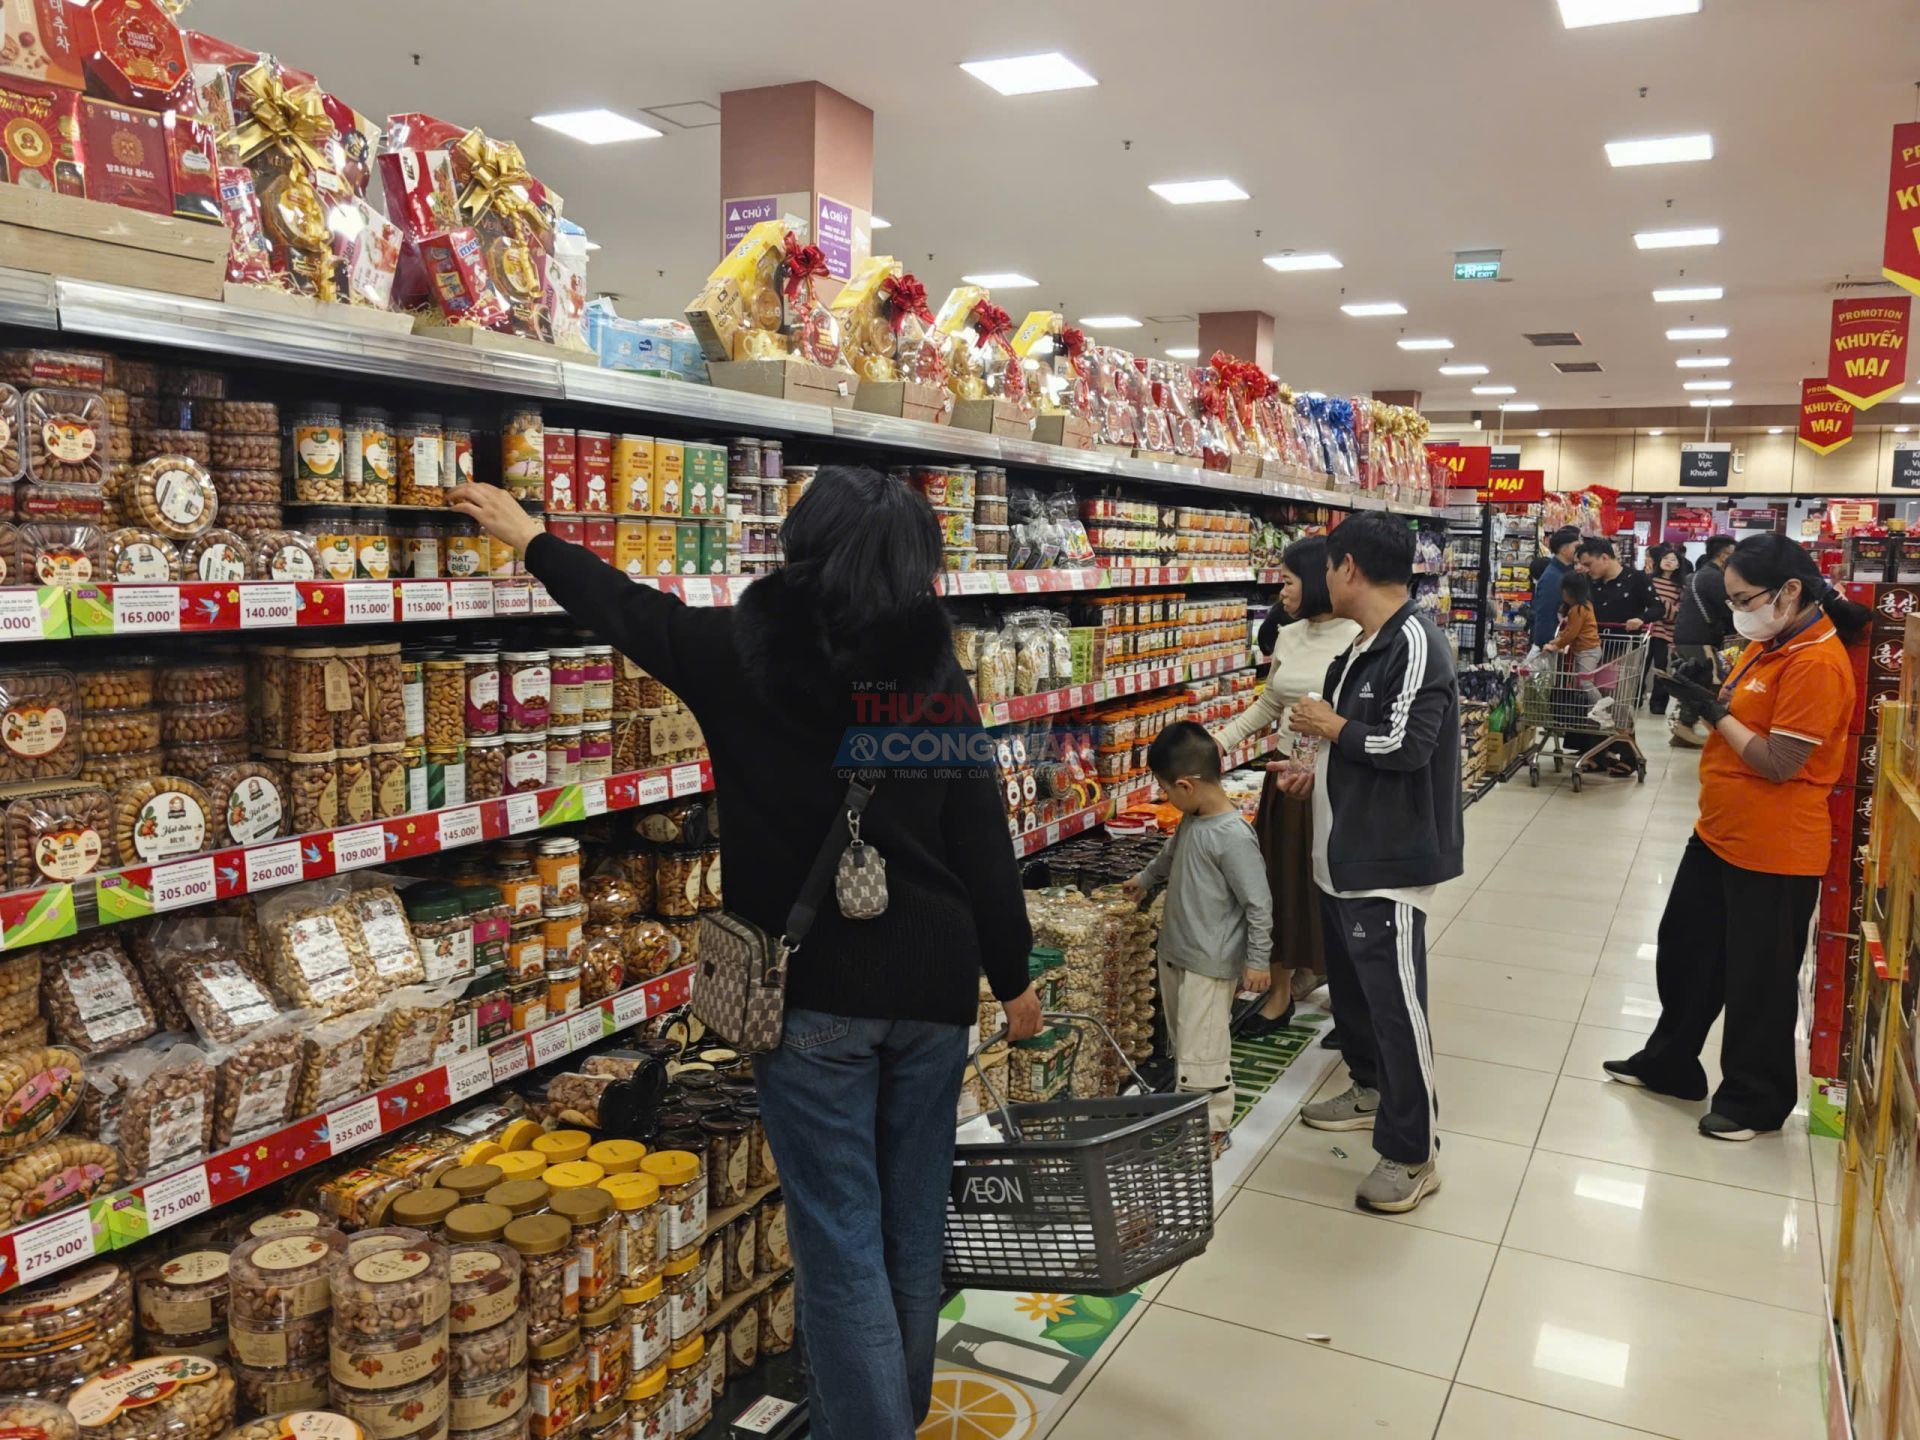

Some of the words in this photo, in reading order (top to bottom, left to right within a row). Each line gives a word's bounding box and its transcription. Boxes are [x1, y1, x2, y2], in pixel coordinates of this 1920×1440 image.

[742, 206, 762, 219] CHÚ
[1838, 308, 1904, 323] PROMOTION
[1835, 328, 1904, 351] KHUYẾN
[1844, 357, 1890, 379] MẠI
[1811, 418, 1843, 434] MẠI
